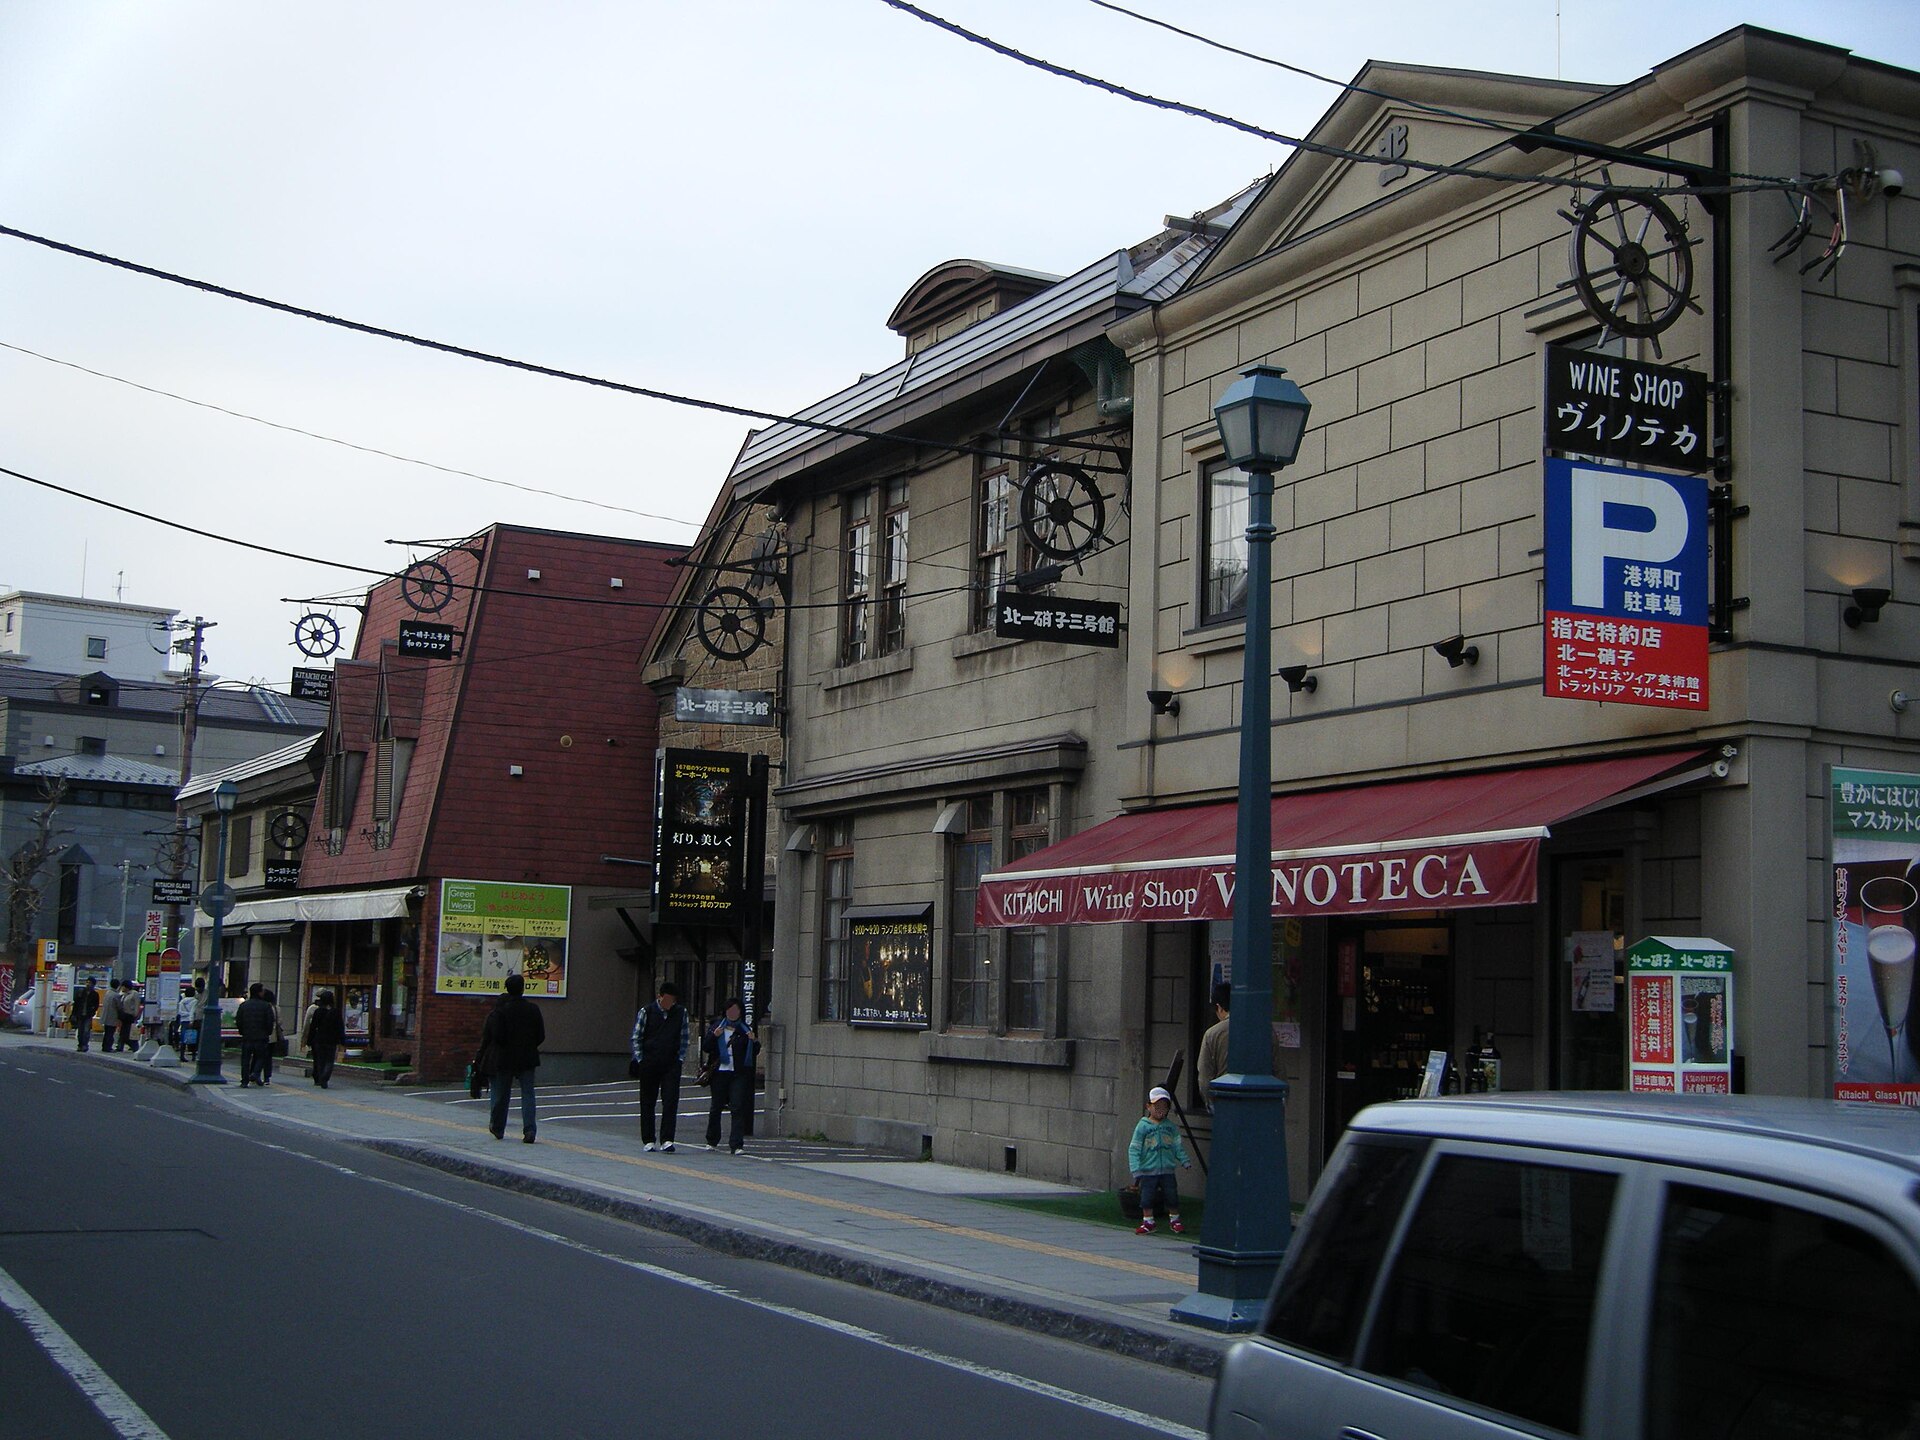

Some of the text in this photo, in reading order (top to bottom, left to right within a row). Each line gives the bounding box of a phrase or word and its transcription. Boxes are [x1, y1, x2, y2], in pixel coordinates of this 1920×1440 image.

[1569, 361, 1684, 410] WINE SHOP
[1557, 402, 1698, 455] ヴィノテカ
[1571, 468, 1689, 608] P
[1623, 565, 1681, 591] 港堺町
[1624, 591, 1683, 617] 駐車場
[1003, 606, 1115, 635] 北一硝子三号館
[1551, 617, 1662, 648] 指定特約店
[407, 639, 446, 650] 和のフロア
[1557, 644, 1636, 667] 北一硝子
[1559, 679, 1700, 703] トラットリア マルコポーロ
[680, 698, 770, 716] 北一硝子三号館
[672, 832, 732, 847] 灯り、美しく
[450, 889, 475, 900] Green
[1003, 853, 1489, 916] KITAICHI Wine Shop VNOTECA
[451, 901, 473, 910] Week
[699, 900, 732, 910] 洋のフロア
[48, 943, 55, 953] P
[1630, 954, 1673, 969] 北一硝子
[1680, 954, 1727, 970] 北一硝子
[446, 979, 474, 989] 北一硝子
[743, 961, 756, 1031] 北一硝子三号
[1647, 982, 1661, 1053] 送料無料
[1634, 1074, 1674, 1087] 当社直輸入
[1838, 1090, 1869, 1100] Kitaichi
[1874, 1090, 1898, 1100] Glass
